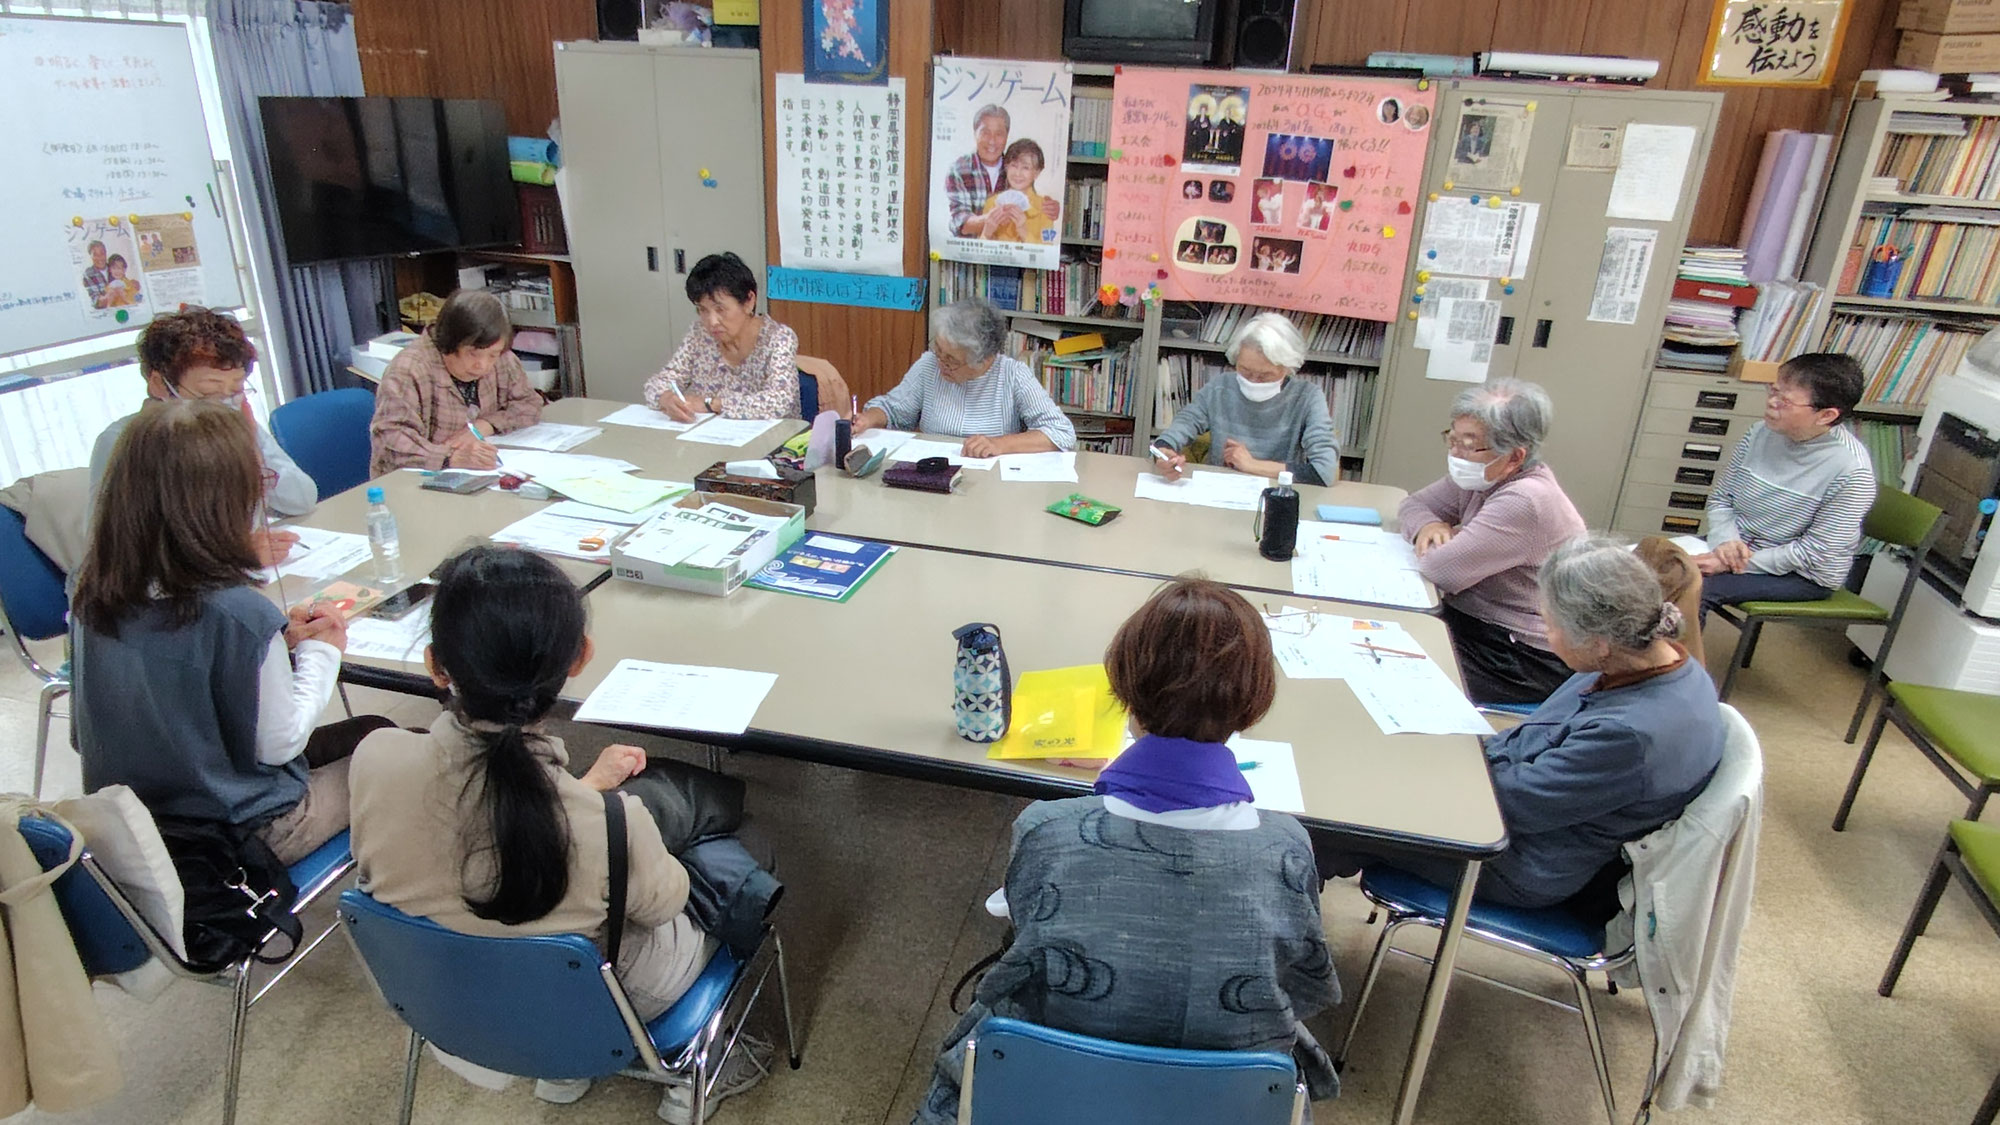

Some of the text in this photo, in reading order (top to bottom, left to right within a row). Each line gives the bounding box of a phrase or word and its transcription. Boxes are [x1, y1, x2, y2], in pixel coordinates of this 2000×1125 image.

[1731, 7, 1820, 46] 感動を
[1746, 45, 1817, 78] 伝えよう
[937, 64, 1067, 107] ジン・ゲーム
[801, 99, 813, 258] 日本演劇の民主的発展を目
